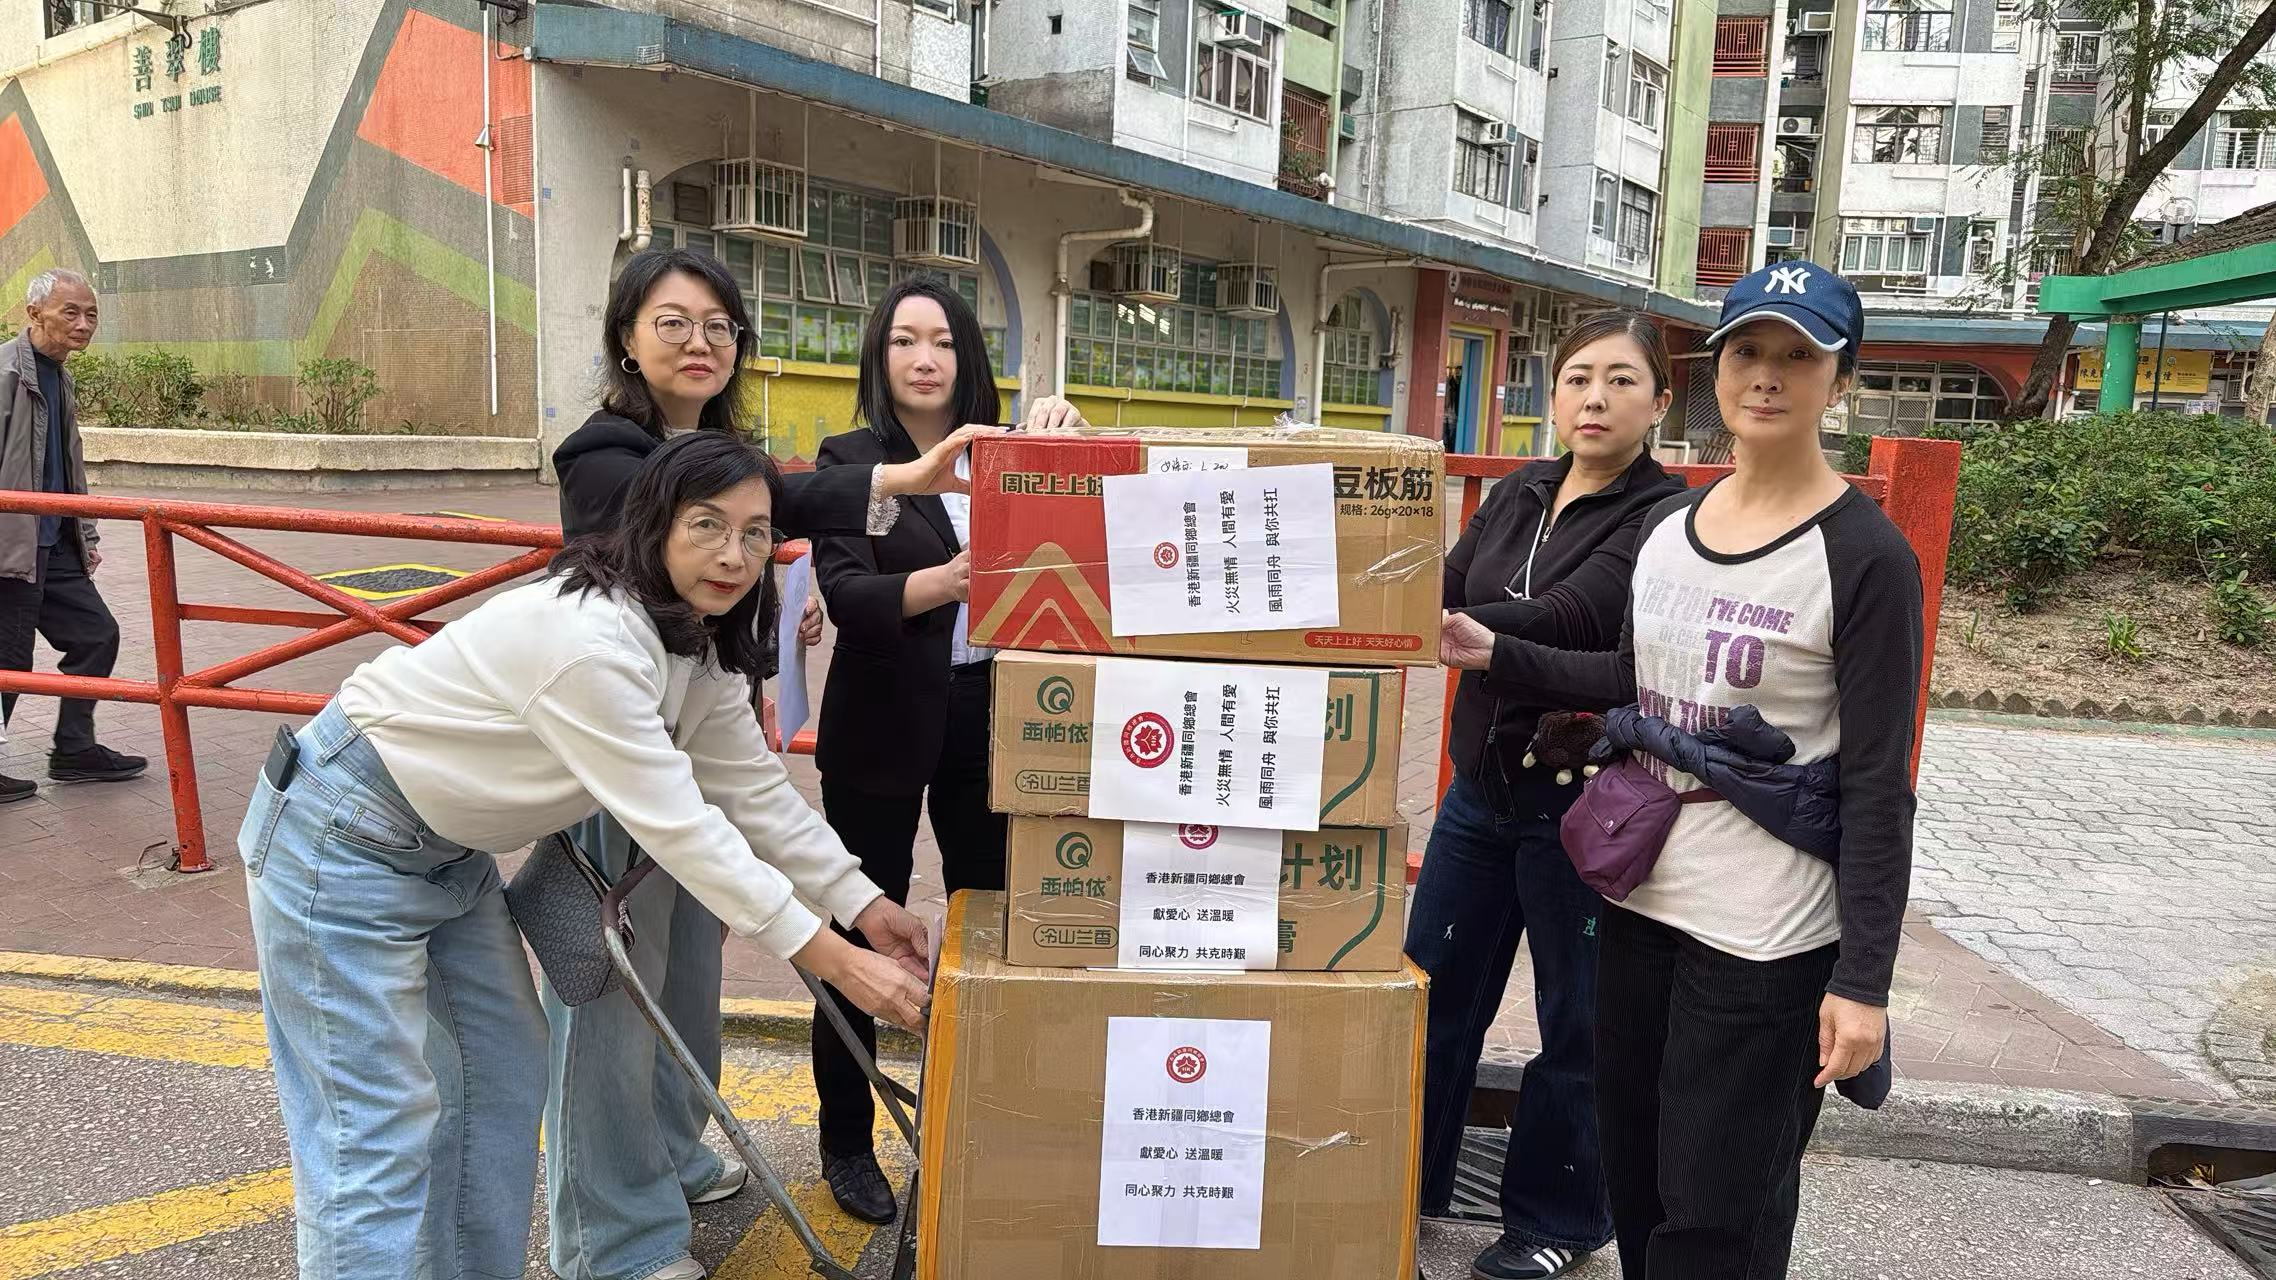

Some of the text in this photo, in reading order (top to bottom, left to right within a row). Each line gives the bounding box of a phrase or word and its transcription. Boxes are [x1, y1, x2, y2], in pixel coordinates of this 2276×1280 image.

[1764, 267, 1811, 294] NY
[1333, 466, 1435, 501] 豆板筋
[1183, 501, 1202, 608] 香港新疆同鄉總會
[1219, 490, 1241, 614] 火災無情 人間有愛
[1263, 487, 1283, 612] 風雨同舟 與你共扛
[1738, 603, 1795, 634] COME
[1314, 635, 1362, 647] 天天上上好
[1704, 629, 1765, 689] TO
[1178, 690, 1199, 796] 香港新疆同鄉總會
[1215, 684, 1238, 807] 火災無情 人間有愛
[1258, 686, 1281, 810] 風雨同舟 與你共扛
[1145, 871, 1246, 886] 香港新疆同鄉總會
[1152, 907, 1235, 922] 獻愛心 送溫暖
[1139, 945, 1246, 960] 同心聚力 共克時艱
[1132, 1107, 1235, 1124] 香港新疆同鄉總會
[1139, 1146, 1224, 1161] 獻愛心 送溫暖
[1125, 1183, 1234, 1200] 同心聚力 共克時艱
